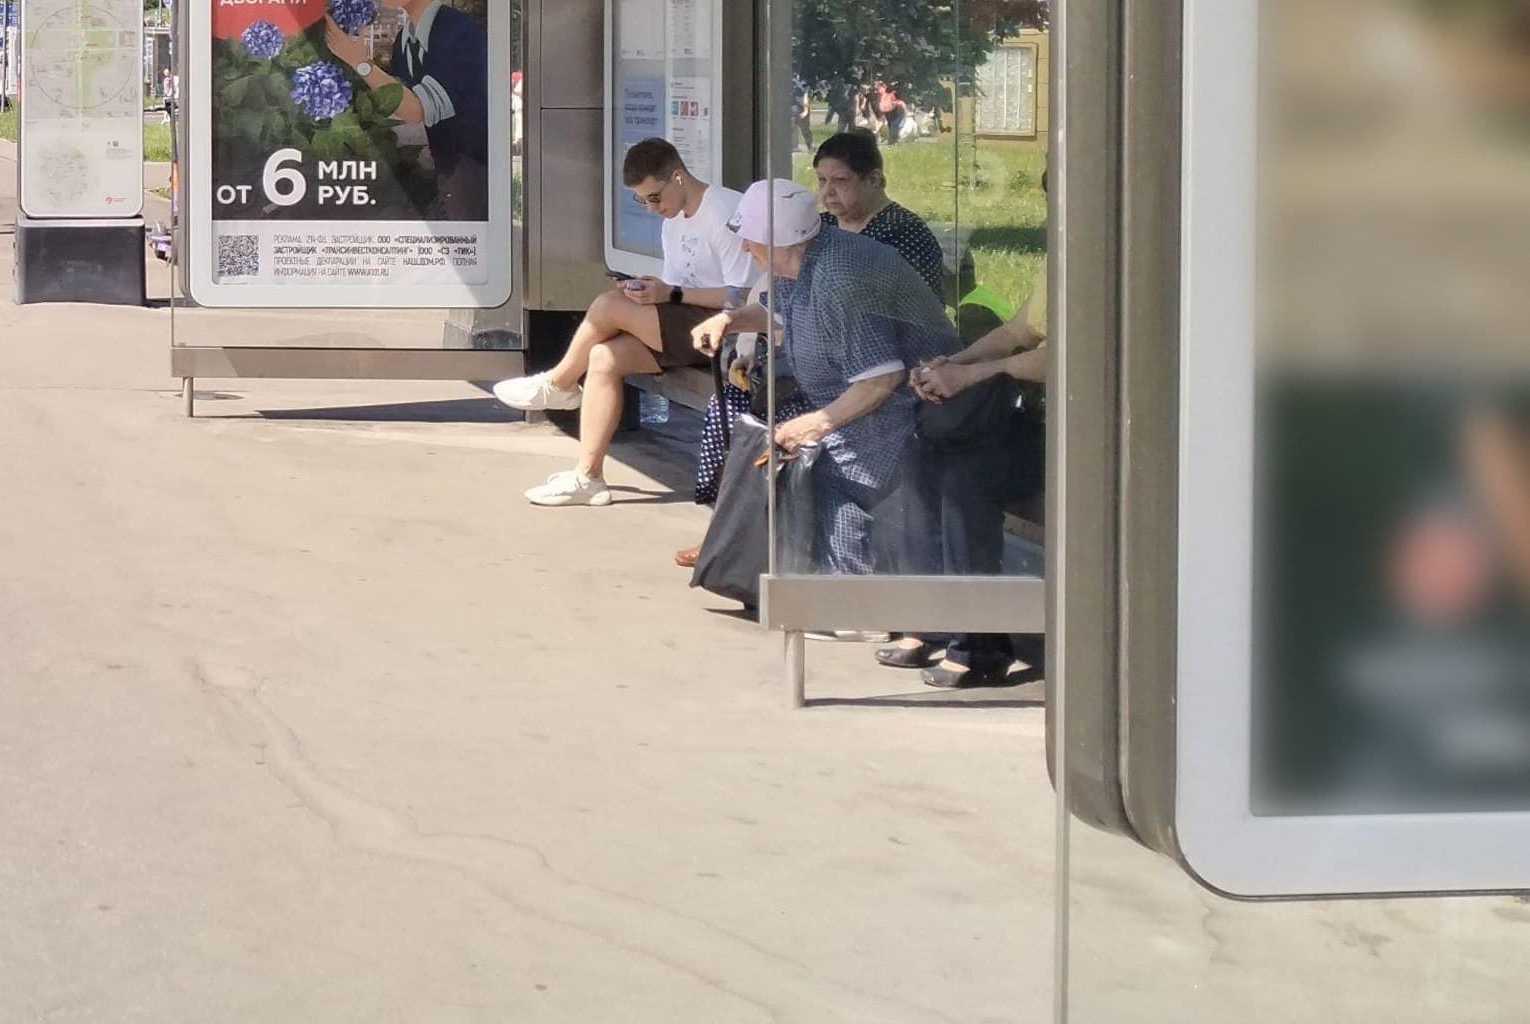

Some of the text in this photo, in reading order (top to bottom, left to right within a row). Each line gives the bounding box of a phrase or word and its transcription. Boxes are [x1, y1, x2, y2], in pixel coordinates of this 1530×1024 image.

[216, 148, 376, 206] ОТ 6 МЛН
[318, 185, 376, 206] РУБ.
